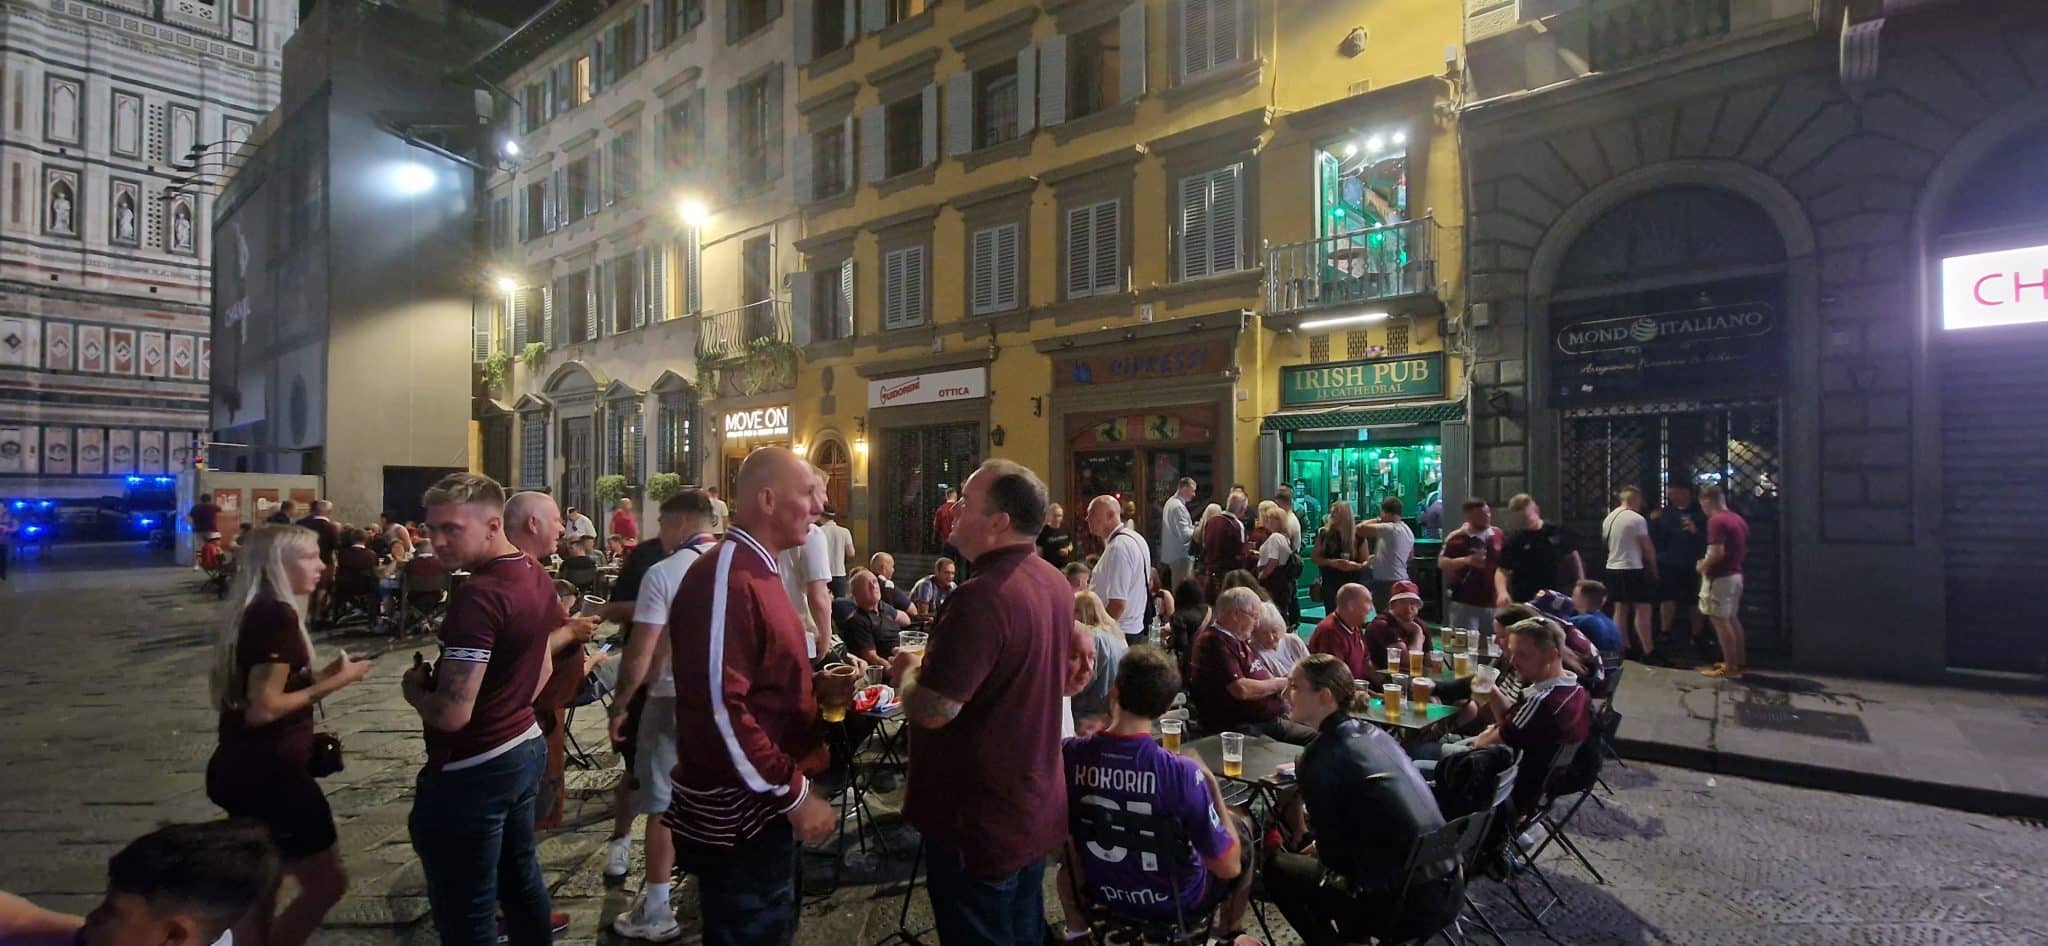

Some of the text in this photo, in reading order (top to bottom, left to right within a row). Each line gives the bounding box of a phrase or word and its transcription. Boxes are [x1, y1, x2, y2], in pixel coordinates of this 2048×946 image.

[1659, 311, 1763, 337] ITALIANO
[1296, 360, 1429, 390] IRISH PUB
[938, 386, 970, 398] OTTICA
[1331, 382, 1406, 398] CATHEDRAL
[725, 406, 788, 432] MOVE ON
[1075, 764, 1156, 794] KOKORIN
